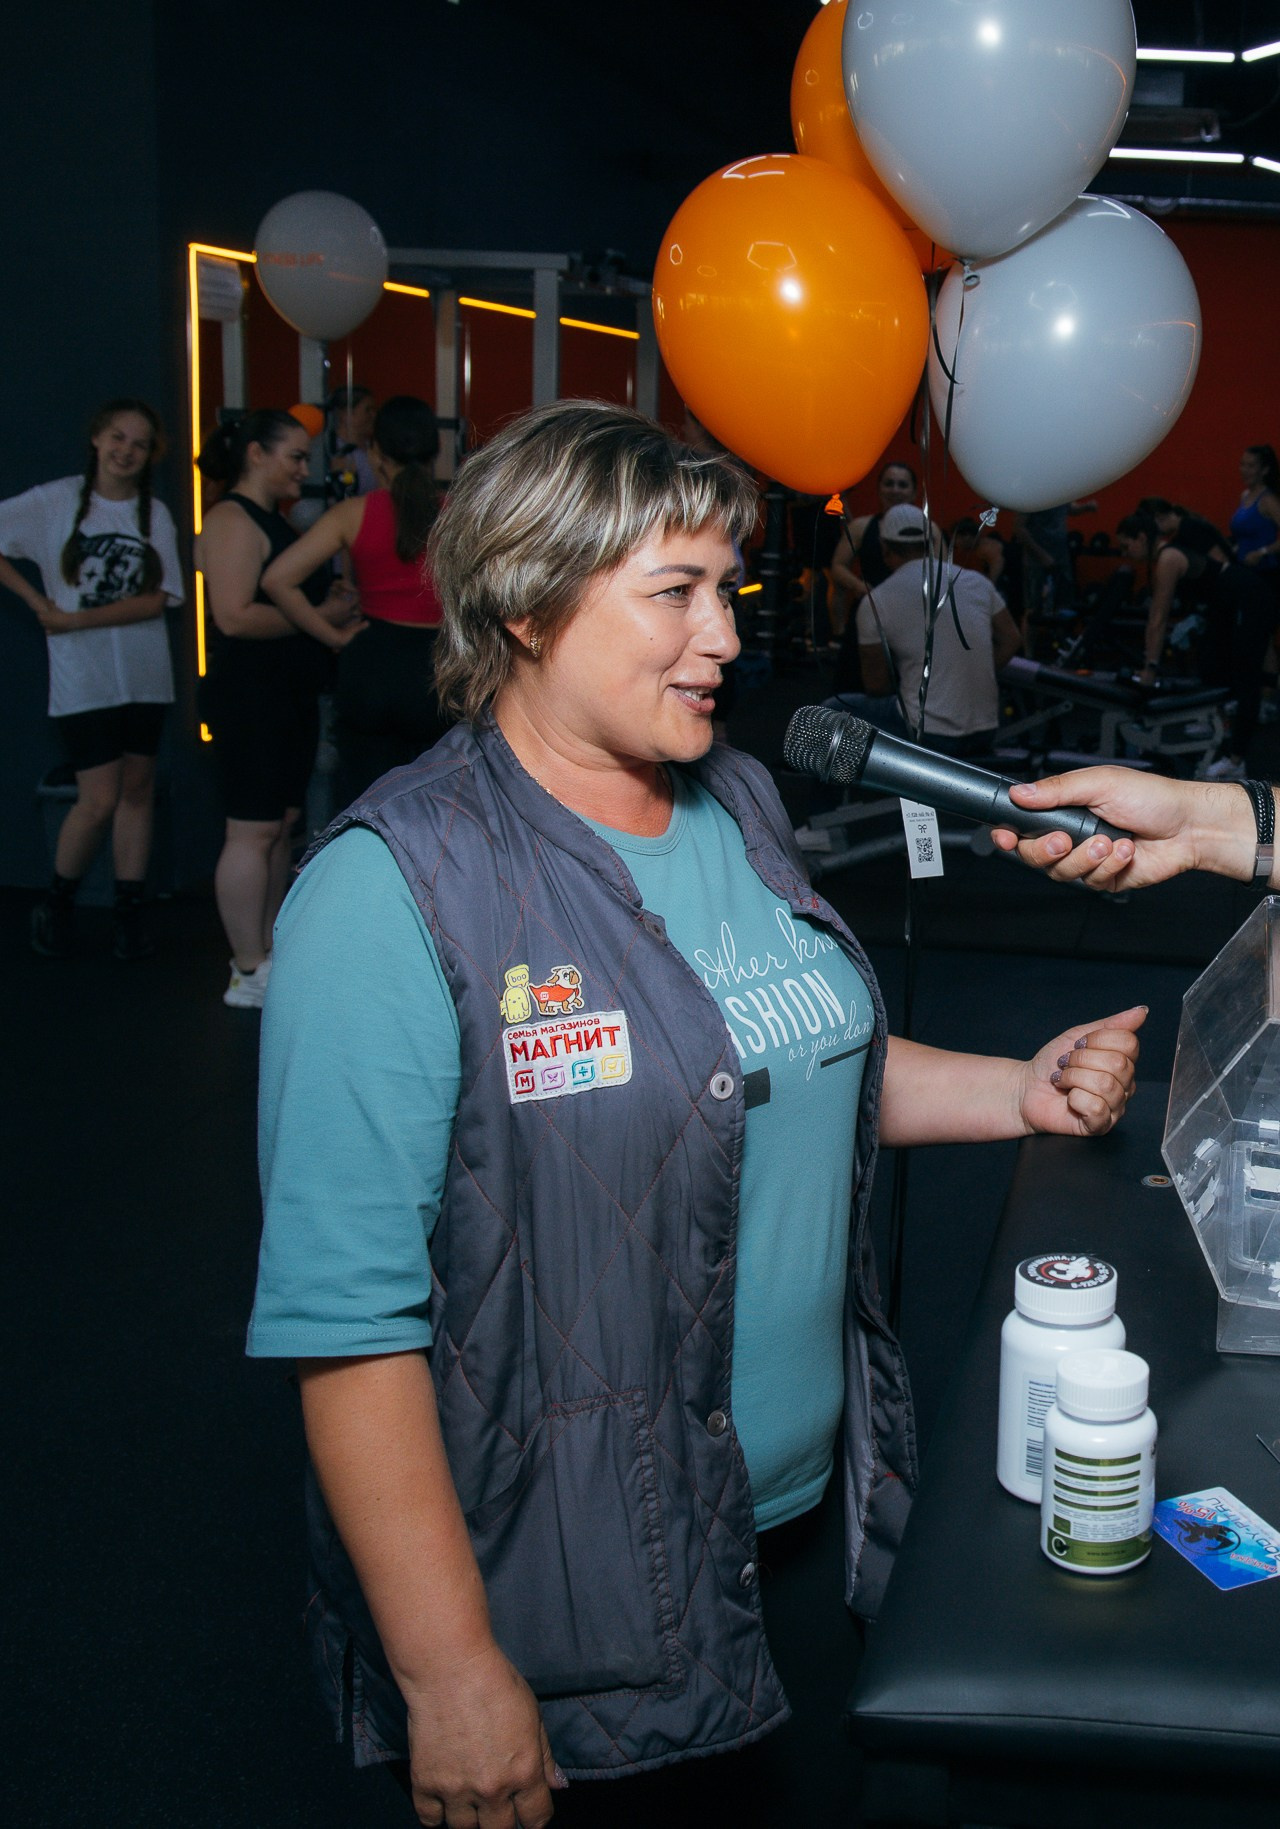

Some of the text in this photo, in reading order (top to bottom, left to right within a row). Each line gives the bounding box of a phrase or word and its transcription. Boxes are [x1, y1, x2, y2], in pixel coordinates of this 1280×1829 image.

[511, 973, 527, 983] boo
[508, 1017, 601, 1040] семья магазинов
[725, 969, 846, 1059] SHION
[509, 1025, 621, 1063] МАГНИТ
[788, 1045, 808, 1062] or
[806, 1033, 841, 1082] you
[1177, 1501, 1216, 1521] 15%
